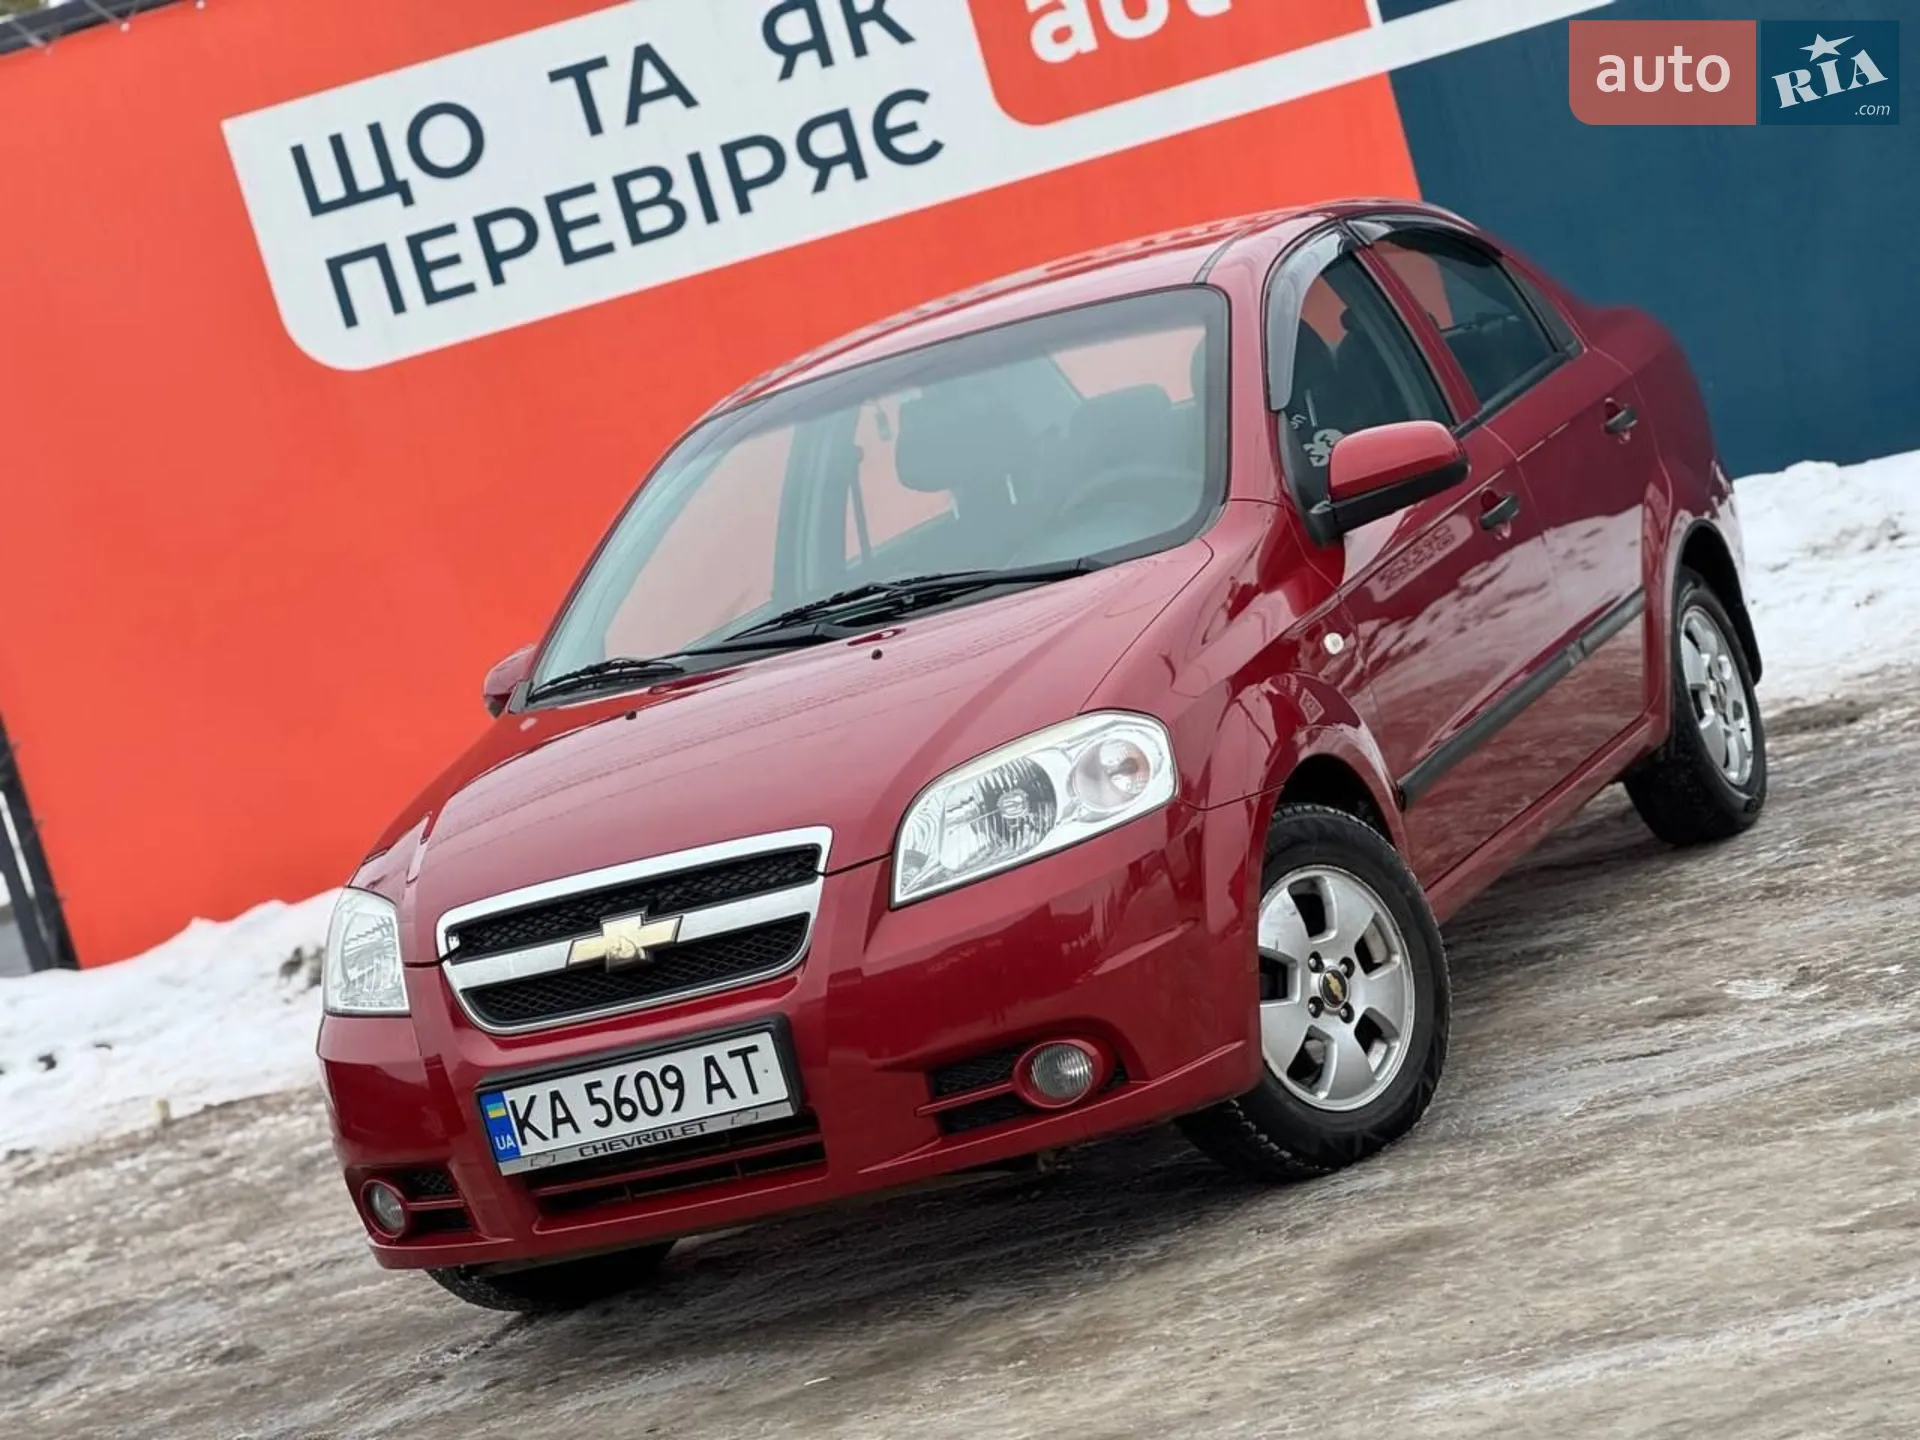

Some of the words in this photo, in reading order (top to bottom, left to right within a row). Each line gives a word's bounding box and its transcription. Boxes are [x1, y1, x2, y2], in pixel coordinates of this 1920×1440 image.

[290, 102, 485, 217] ЩО
[548, 43, 700, 137] ТА
[762, 0, 916, 82] ЯК
[325, 88, 945, 328] ПЕРЕВІРЯЄ
[495, 1132, 517, 1151] UA
[508, 1089, 581, 1146] KA
[584, 1064, 685, 1129] 5609
[703, 1044, 760, 1105] AT
[578, 1120, 709, 1159] CHEVROLET
